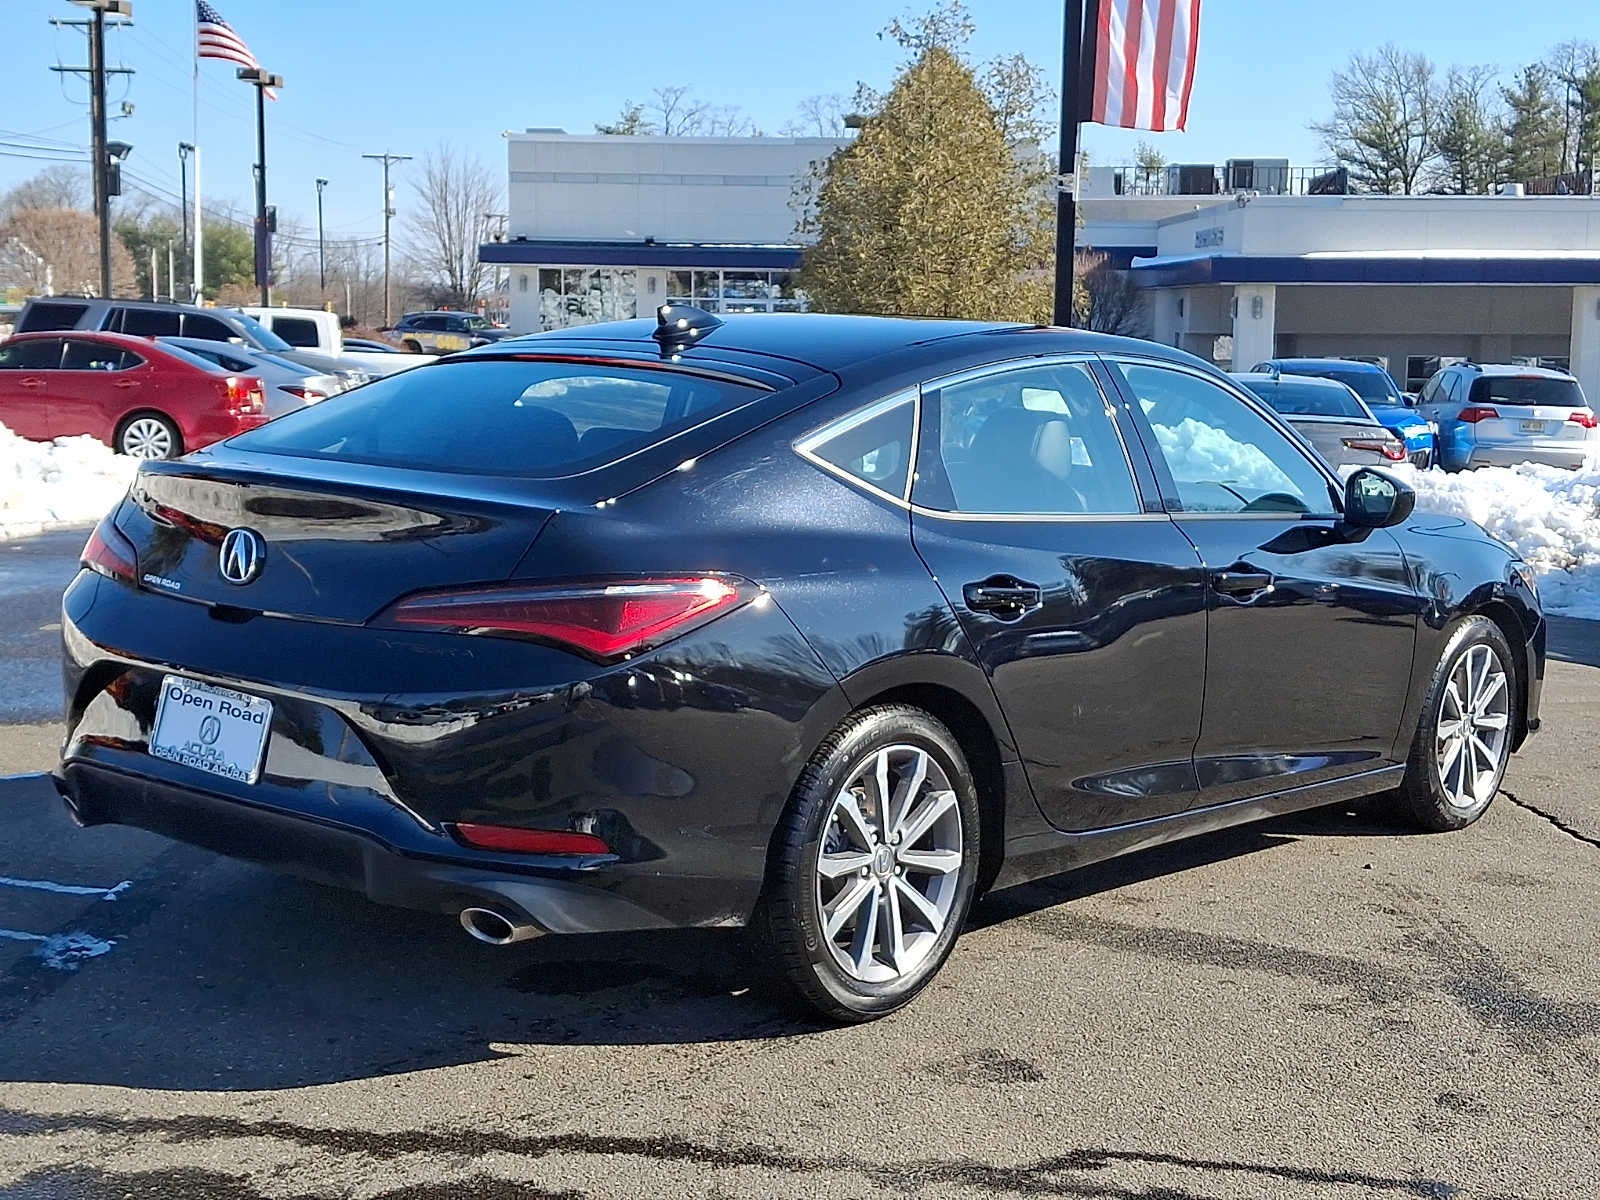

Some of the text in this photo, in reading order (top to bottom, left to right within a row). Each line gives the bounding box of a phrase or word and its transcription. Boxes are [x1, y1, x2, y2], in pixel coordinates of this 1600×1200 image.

[169, 687, 213, 711] Open
[219, 701, 264, 725] Road
[155, 747, 246, 780] OPEN ROAD ACURA
[180, 740, 225, 763] ACURA
